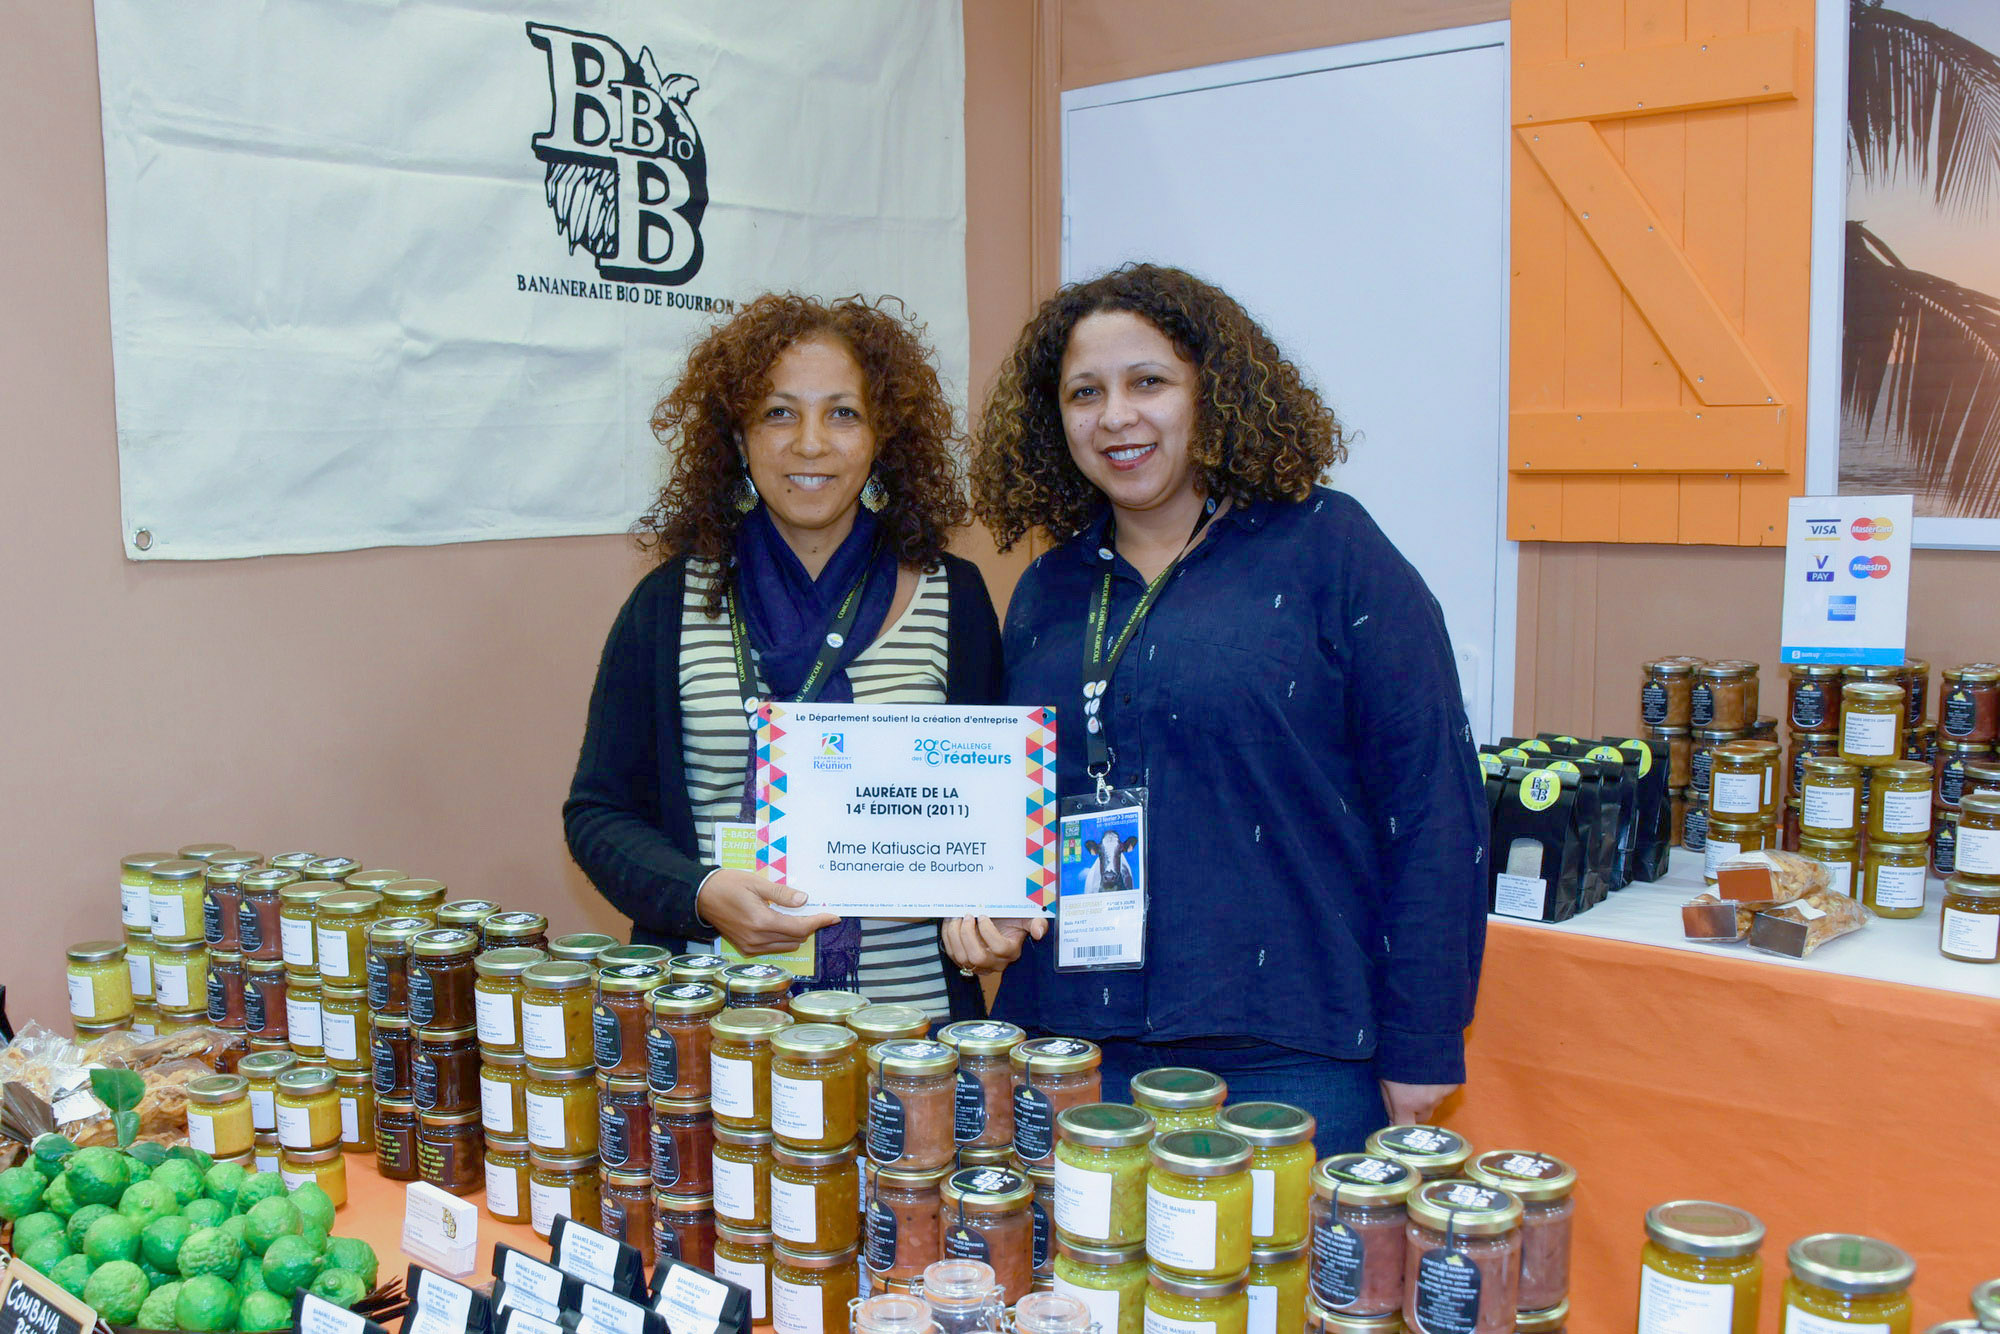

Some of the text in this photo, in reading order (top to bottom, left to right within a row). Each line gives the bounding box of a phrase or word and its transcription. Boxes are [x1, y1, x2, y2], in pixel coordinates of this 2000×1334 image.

[517, 274, 735, 315] BANANERAIE BIO DE BOURBON
[1810, 525, 1893, 535] VISA MasterCard
[1811, 563, 1888, 581] PAY Maestro
[802, 660, 824, 695] AGRICOLE
[795, 713, 1018, 725] Le Département soutient la création d'entreprise
[813, 760, 852, 770] Réunion
[926, 750, 1012, 765] Créateurs
[856, 783, 959, 799] LAURÉATE DE LA
[870, 799, 923, 816] ÉDITION
[926, 803, 970, 818] (2011)
[827, 841, 987, 856] Mme Katiuscia PAYET
[829, 860, 906, 873] Bananeraie
[909, 861, 926, 873] de
[930, 861, 984, 873] Bourbon
[1169, 1205, 1196, 1215] MANGUES
[6, 1280, 61, 1334] COMBAVA
